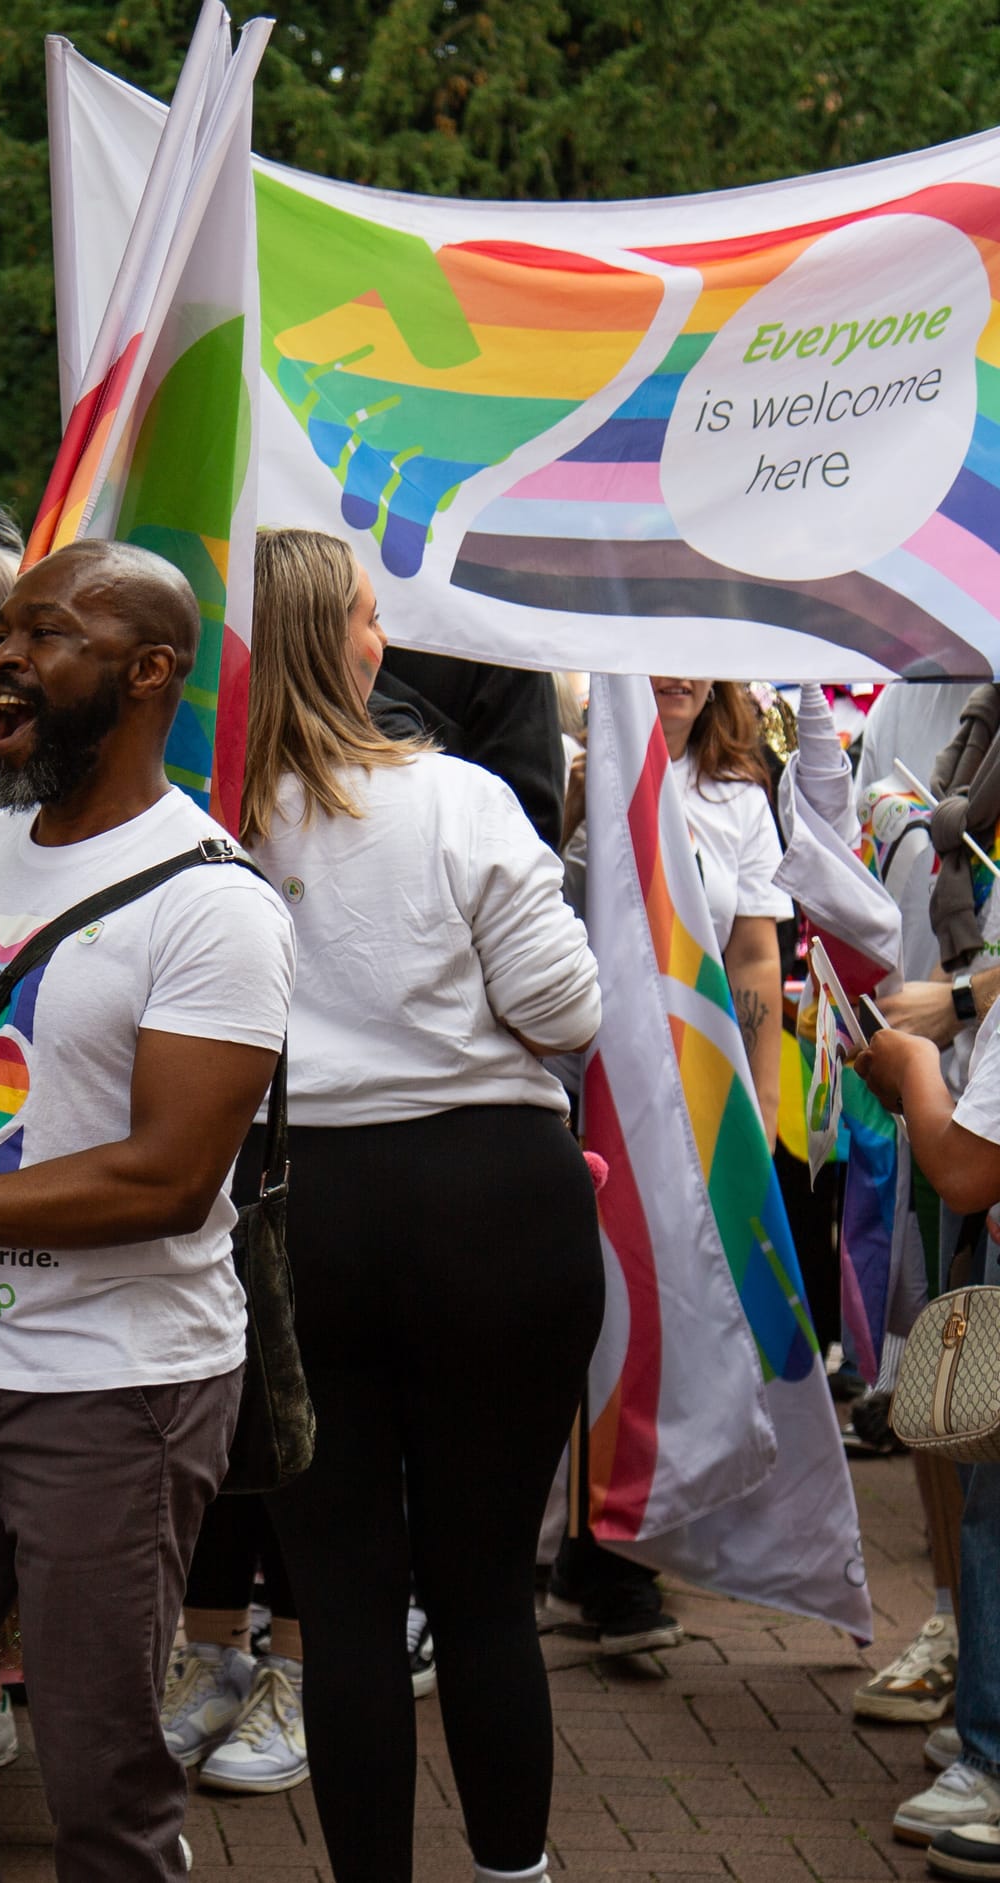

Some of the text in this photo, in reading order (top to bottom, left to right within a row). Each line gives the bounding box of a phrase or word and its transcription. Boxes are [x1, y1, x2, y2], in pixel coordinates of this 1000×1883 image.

[742, 305, 953, 366] Everyone
[695, 368, 943, 433] is welcome
[745, 451, 850, 495] here
